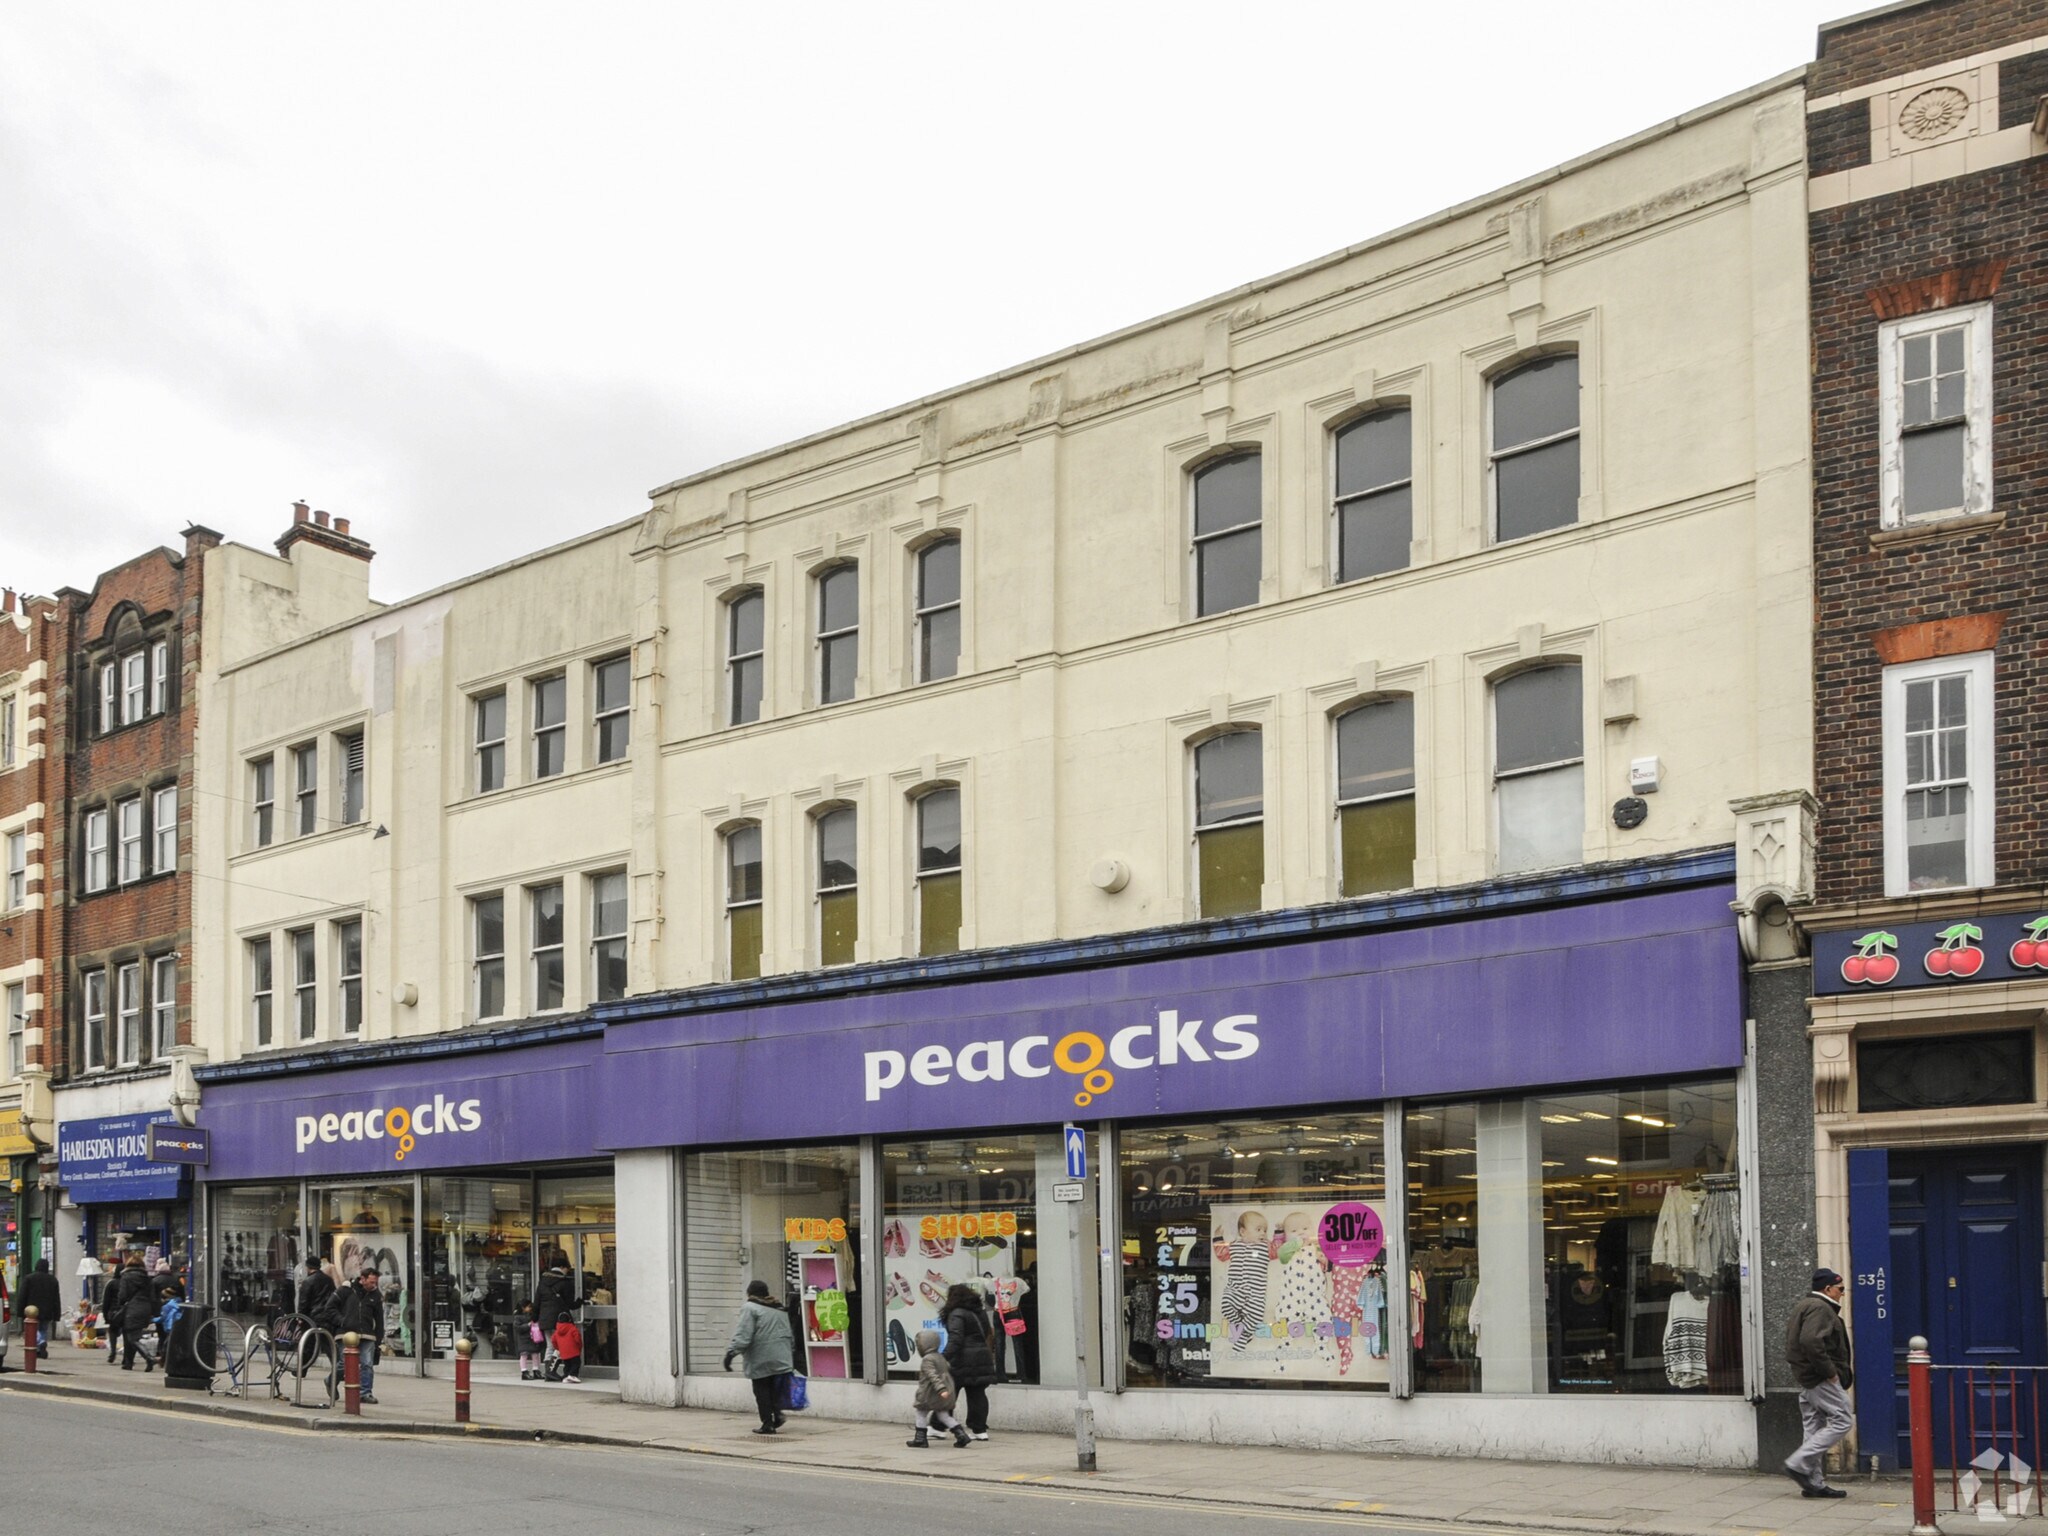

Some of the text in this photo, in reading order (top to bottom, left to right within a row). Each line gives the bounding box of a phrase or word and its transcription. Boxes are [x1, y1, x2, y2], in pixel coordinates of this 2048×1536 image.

[864, 1009, 1260, 1103] peacocks
[296, 1094, 482, 1153] peacocks
[61, 1138, 115, 1162] HARLESDEN
[156, 1139, 204, 1151] peacocks
[785, 1217, 847, 1242] KIDS
[919, 1212, 1018, 1241] SHOES
[1155, 1226, 1197, 1243] 2 Packs
[1325, 1212, 1378, 1242] 30% OFF
[1157, 1236, 1197, 1267] £7
[1157, 1274, 1197, 1291] 3 Packs
[1858, 1274, 1876, 1286] 53
[1876, 1267, 1886, 1278] A
[1876, 1279, 1886, 1291] B
[816, 1291, 845, 1301] FLATS
[1158, 1283, 1199, 1314] £5
[1876, 1294, 1886, 1306] C
[818, 1302, 850, 1331] £6
[1877, 1307, 1887, 1319] D
[1156, 1316, 1378, 1343] Simply adorable
[1182, 1348, 1314, 1363] baby essentials
